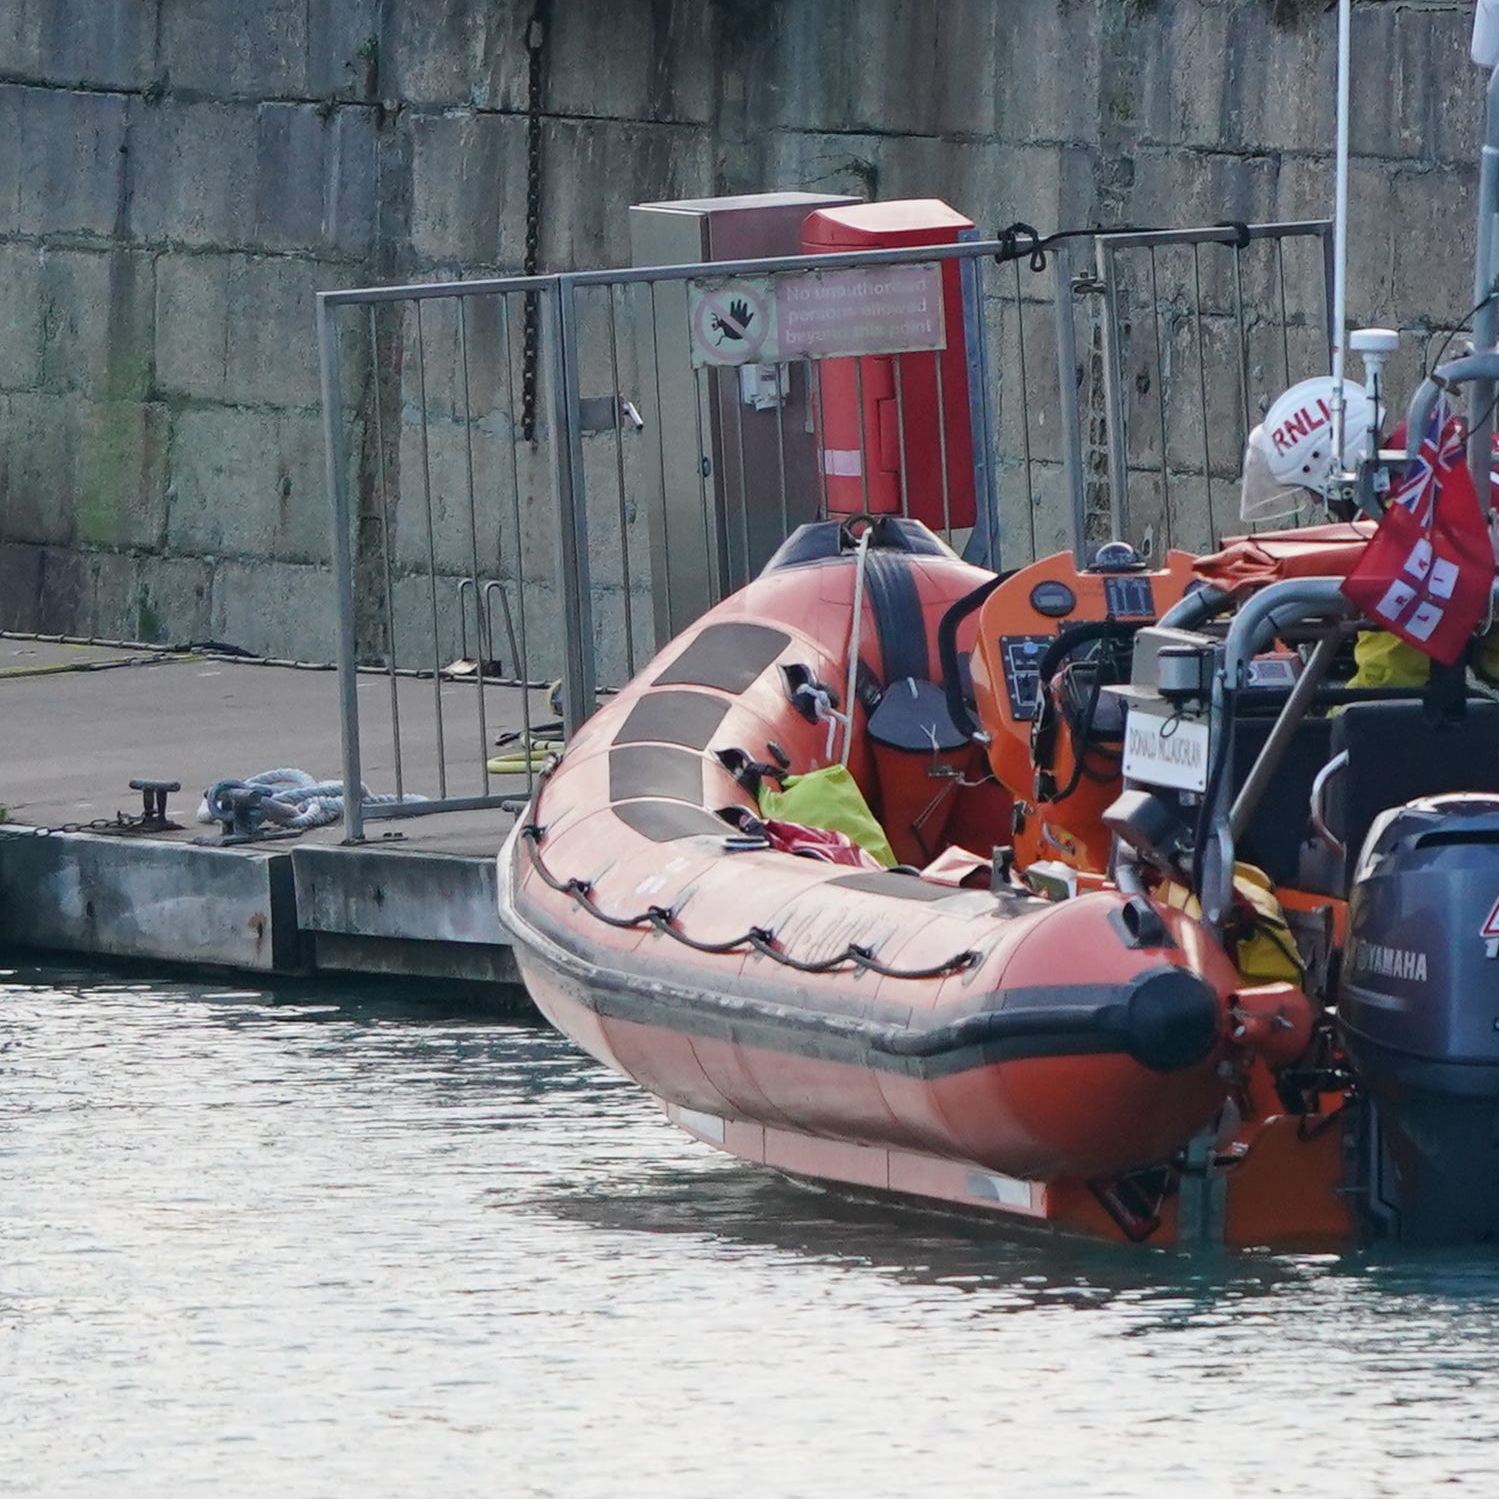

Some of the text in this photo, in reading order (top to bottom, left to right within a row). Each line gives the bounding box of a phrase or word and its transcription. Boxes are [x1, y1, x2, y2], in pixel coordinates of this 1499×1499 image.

[786, 285, 810, 303] No
[1270, 398, 1332, 457] RNLI
[1367, 942, 1428, 982] YAMAHA
